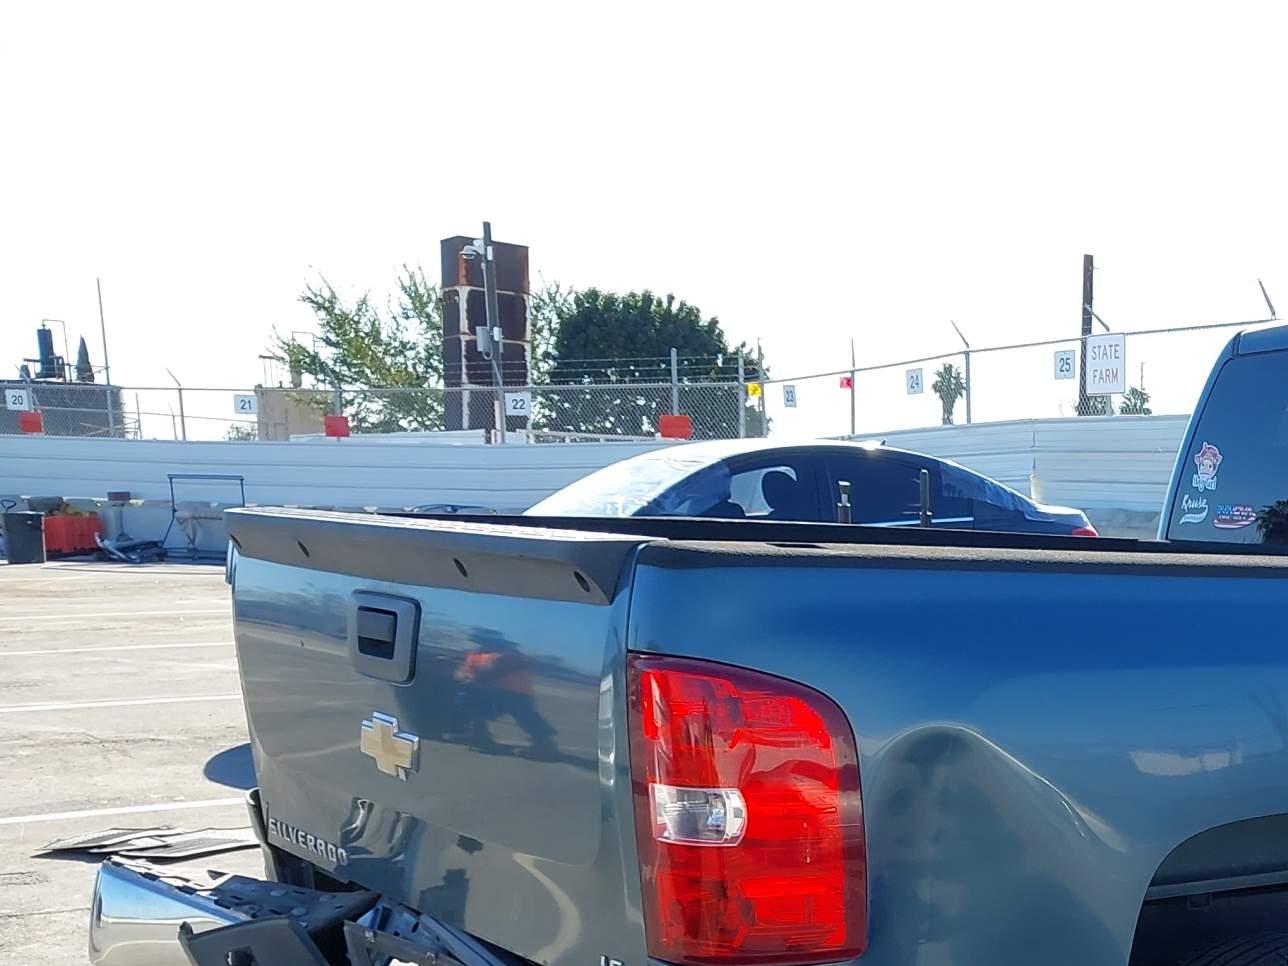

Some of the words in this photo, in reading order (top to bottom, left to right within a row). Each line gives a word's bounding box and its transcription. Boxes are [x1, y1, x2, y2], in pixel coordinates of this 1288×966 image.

[1091, 344, 1120, 361] STATE
[1059, 357, 1071, 373] 25
[909, 375, 920, 389] 24
[1092, 368, 1119, 384] FARM
[11, 394, 24, 406] 20
[240, 399, 252, 410] 21
[511, 398, 526, 410] 22
[268, 817, 348, 867] SILVERADO
